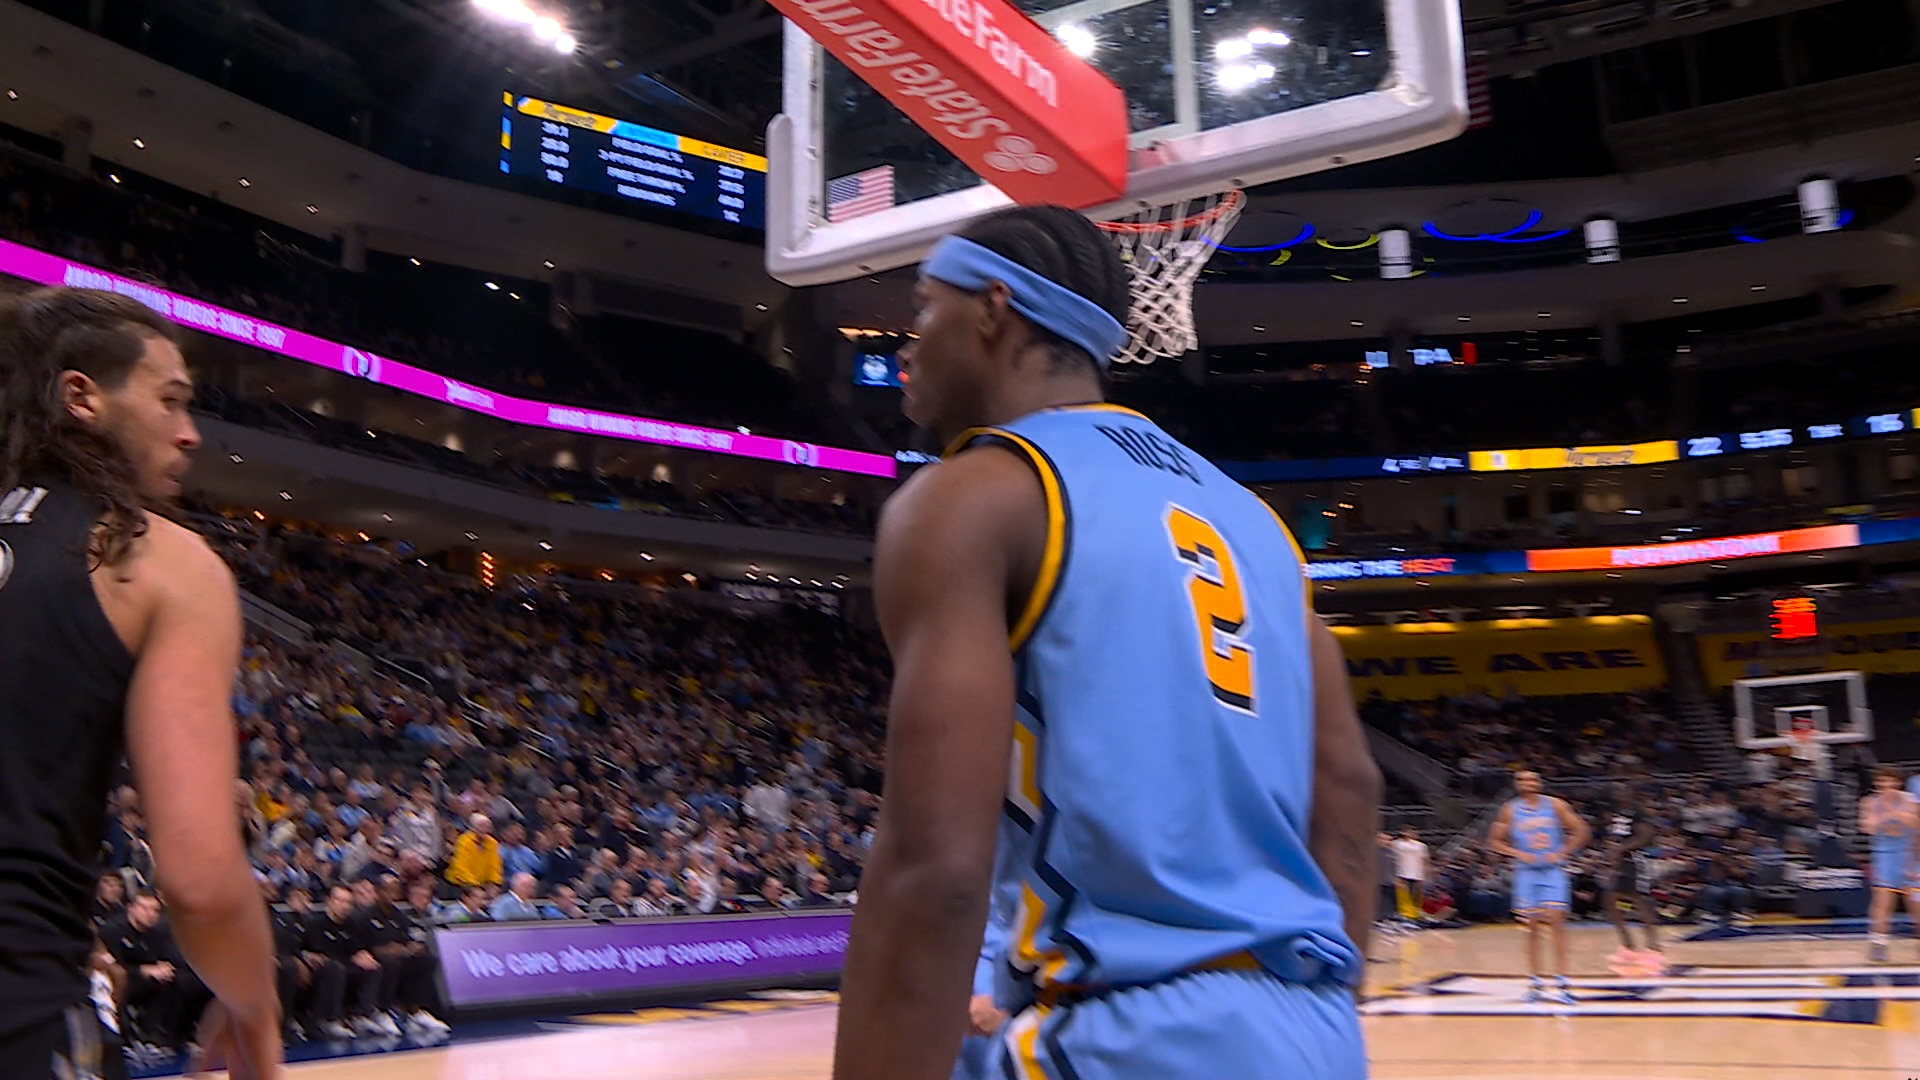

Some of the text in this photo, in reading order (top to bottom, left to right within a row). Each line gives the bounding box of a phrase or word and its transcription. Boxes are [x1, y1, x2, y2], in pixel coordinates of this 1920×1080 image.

[922, 0, 1057, 108] teFarm
[1161, 501, 1259, 719] 2
[1490, 649, 1646, 673] ARE
[460, 949, 505, 978] We
[505, 948, 560, 977] care
[557, 943, 624, 974] about
[621, 944, 669, 974] your
